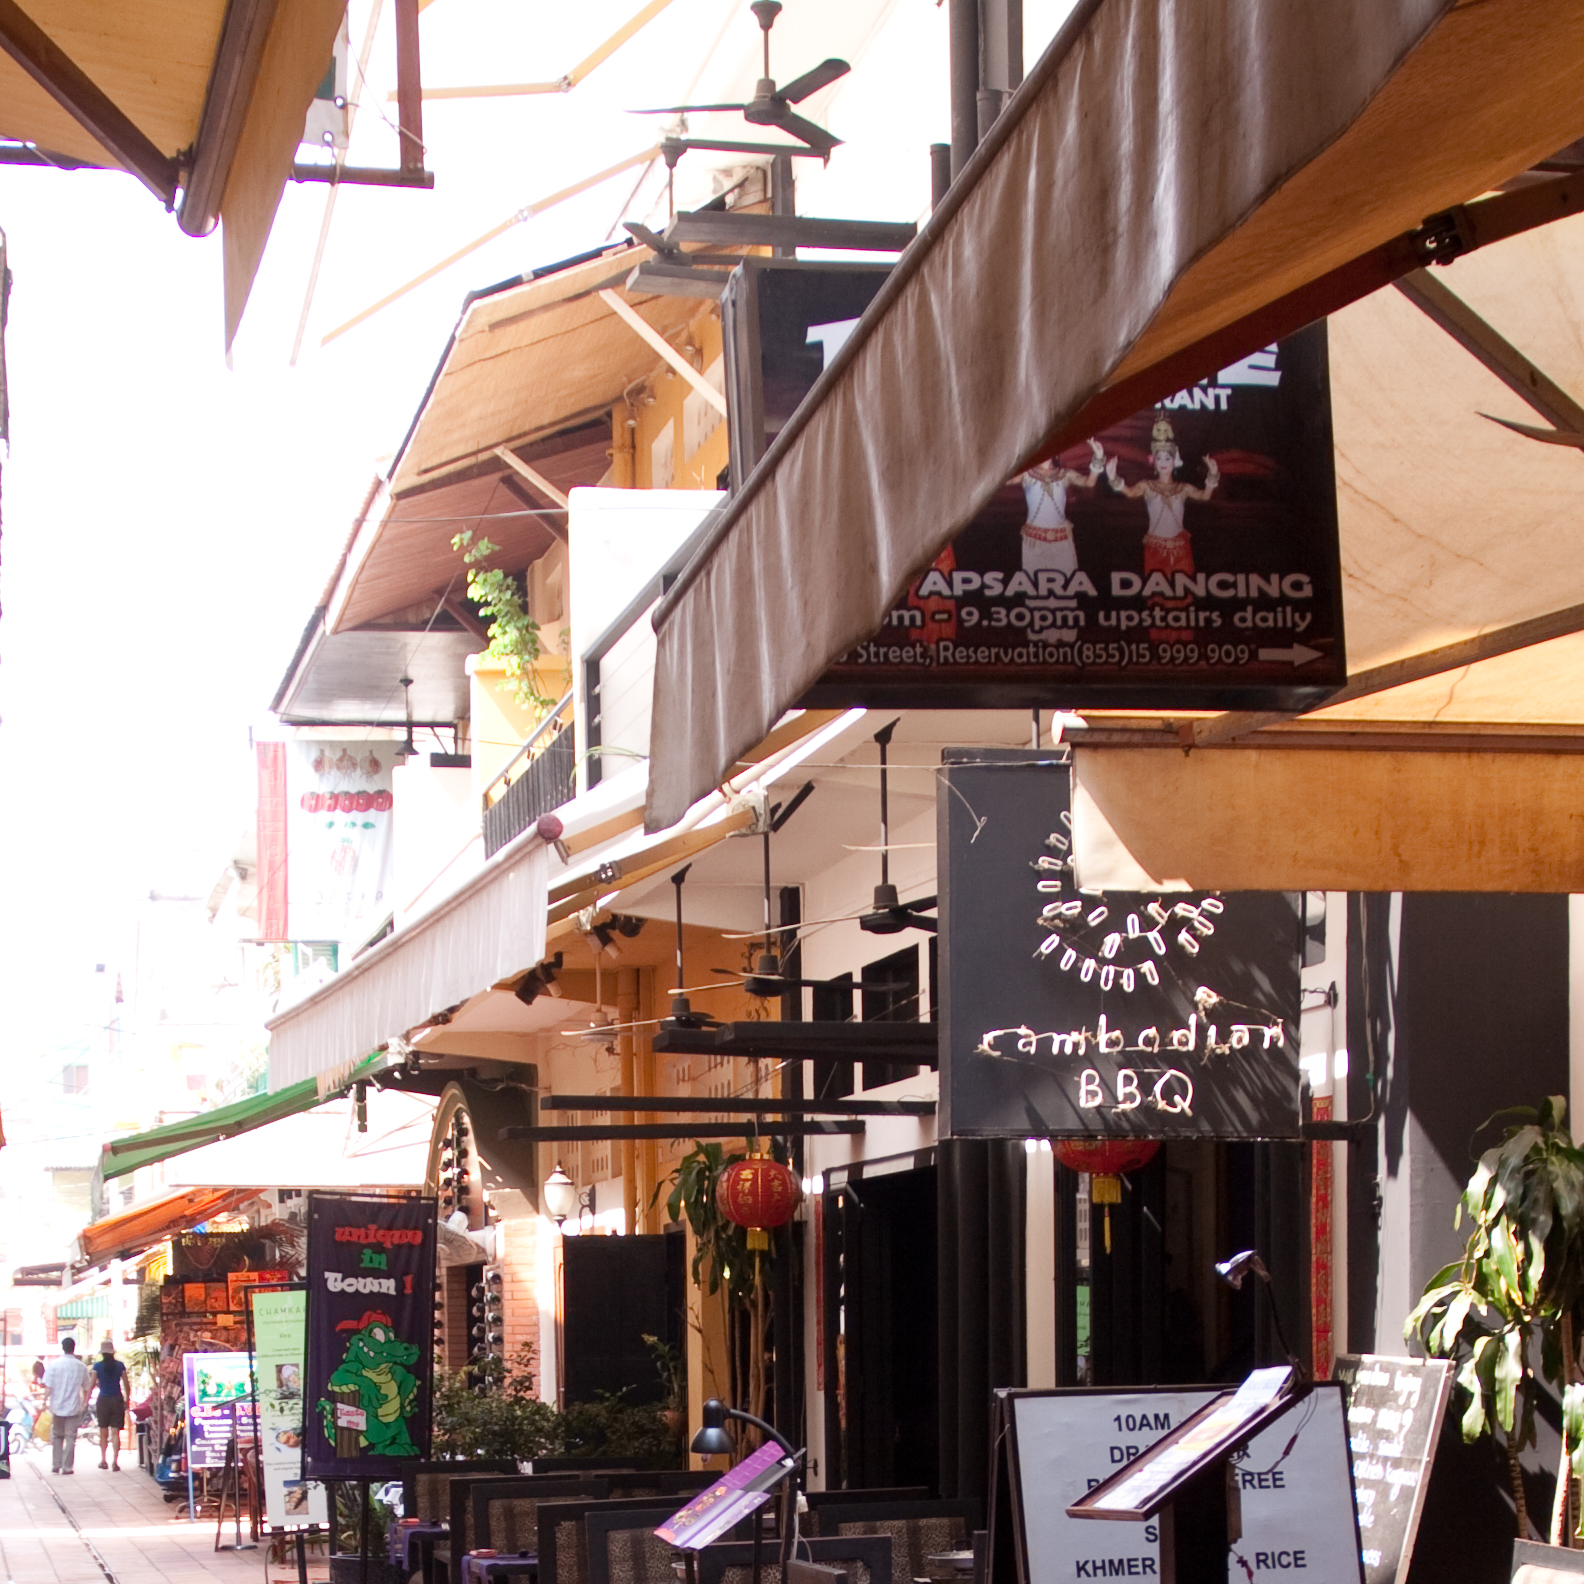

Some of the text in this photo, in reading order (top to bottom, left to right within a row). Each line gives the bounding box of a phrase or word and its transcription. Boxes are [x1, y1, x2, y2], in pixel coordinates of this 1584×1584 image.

[919, 569, 1313, 599] APSARA DANCING
[961, 605, 1086, 632] 9.30pm
[1098, 605, 1221, 632] upstairs
[1232, 605, 1312, 633] daily
[1157, 643, 1200, 664] 999
[1206, 643, 1251, 664] 909
[1079, 1068, 1194, 1117] BBQ
[334, 1223, 423, 1249] unique
[360, 1248, 387, 1270] in
[323, 1271, 396, 1295] Town
[1113, 1412, 1172, 1433] 10AM
[1075, 1557, 1158, 1578] KHMER
[1255, 1550, 1307, 1570] RICE
